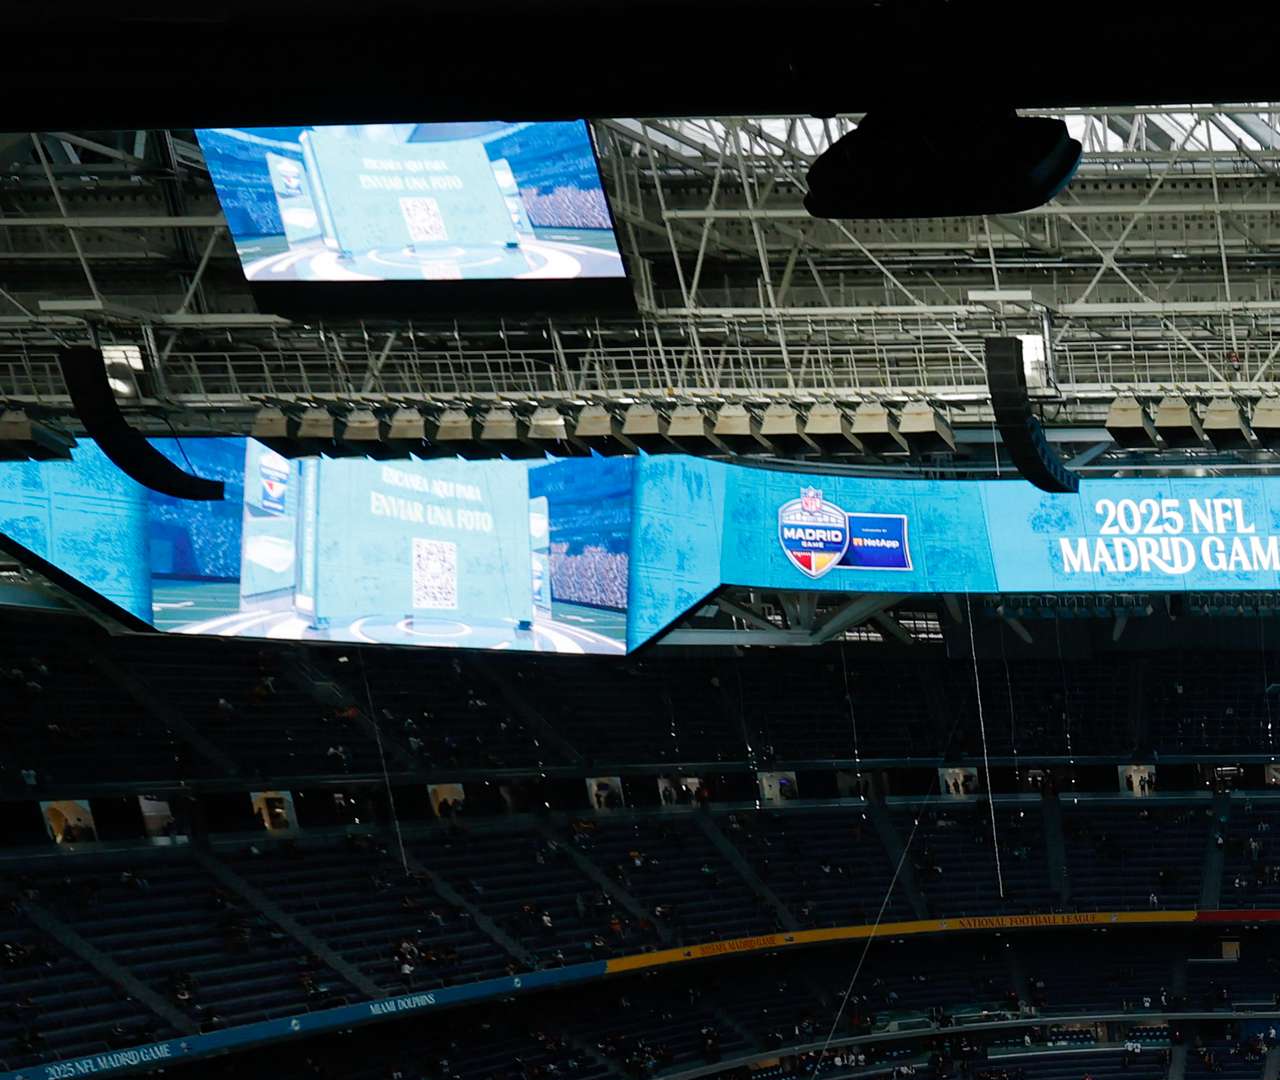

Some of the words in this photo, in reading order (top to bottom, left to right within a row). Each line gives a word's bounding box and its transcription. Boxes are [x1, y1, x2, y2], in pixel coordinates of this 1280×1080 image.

[371, 491, 424, 523] ENVIAR
[457, 509, 493, 532] FOTO
[1095, 498, 1184, 535] 2025
[1188, 498, 1255, 535] NFL
[783, 527, 843, 543] MADRID
[863, 537, 900, 549] NetApp
[1060, 537, 1196, 574] MADRID
[369, 1003, 396, 1015] MIAMI
[46, 1063, 75, 1080] 2025
[76, 1058, 98, 1073] NFL
[96, 1050, 141, 1069] MADRID
[141, 1043, 171, 1061] GAME
